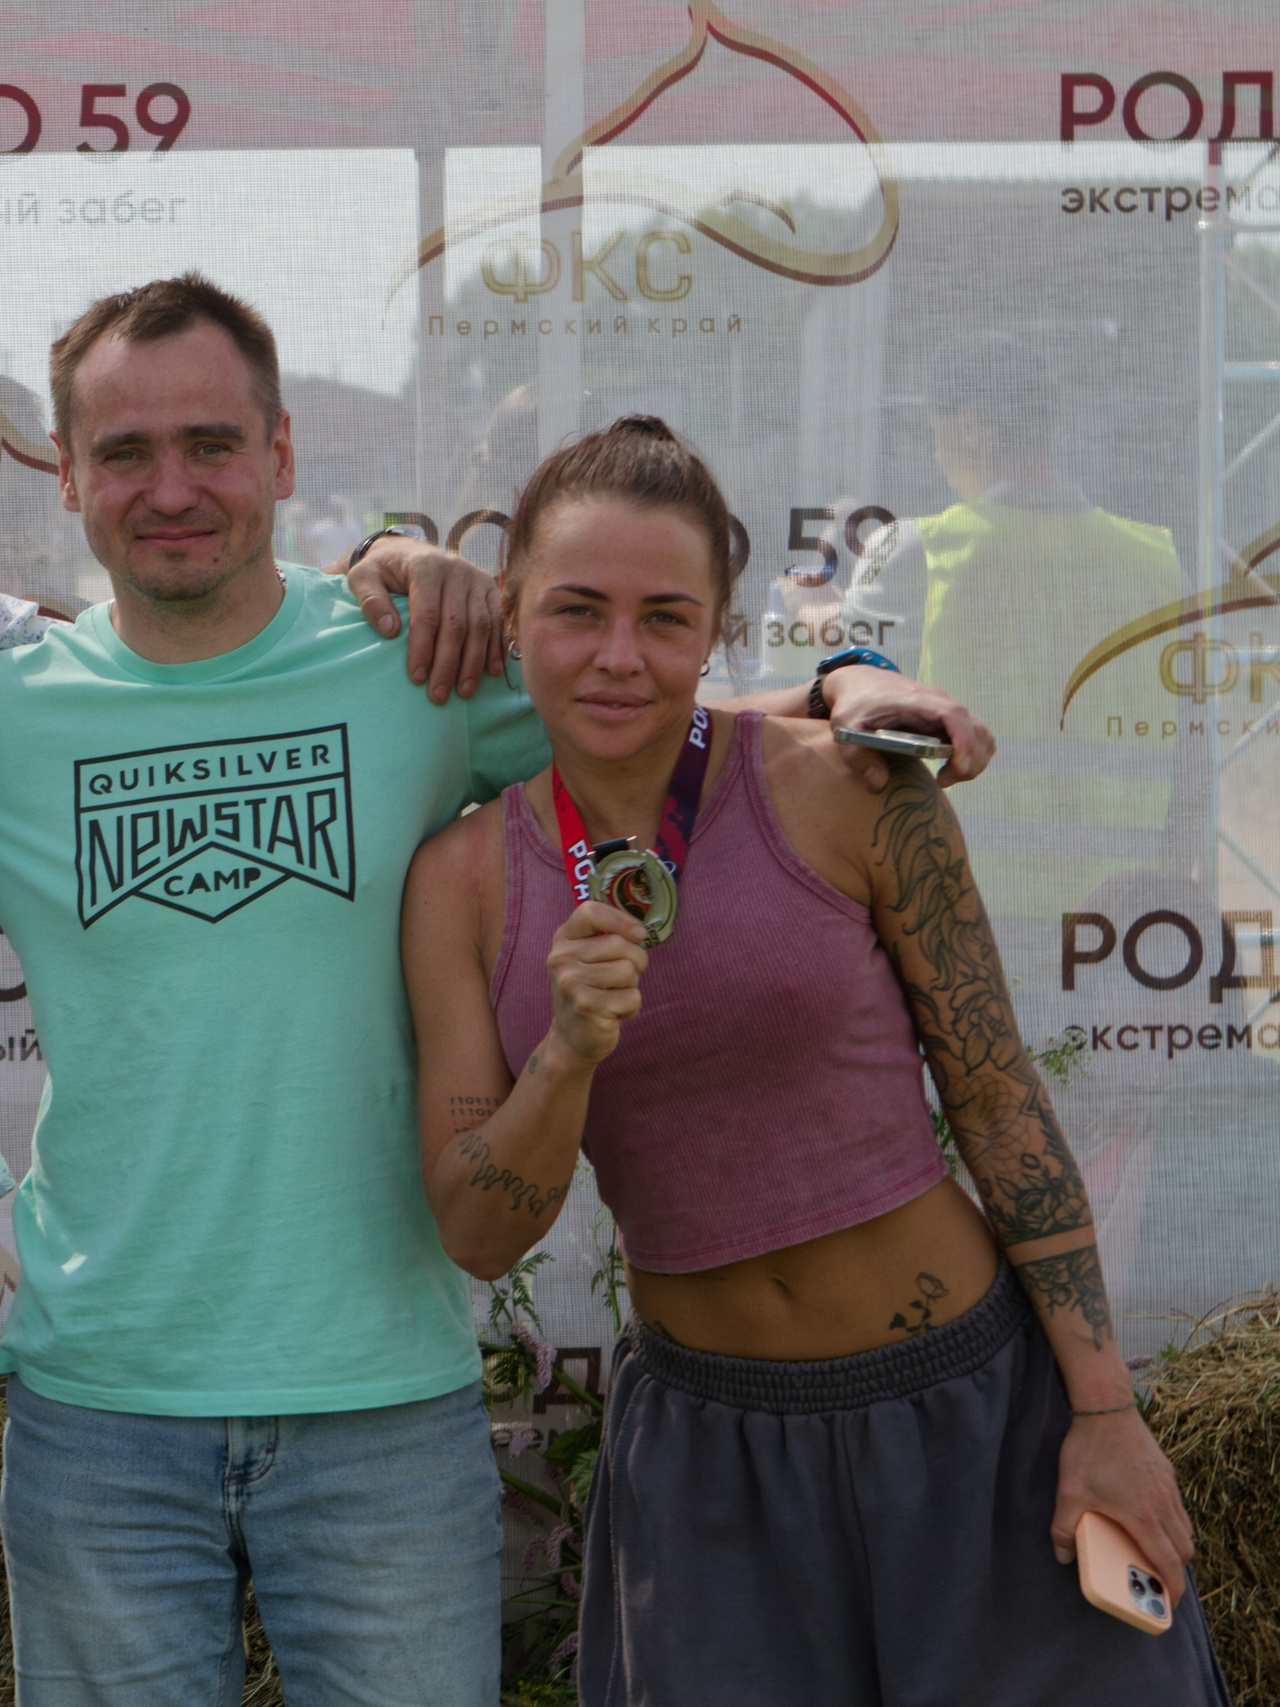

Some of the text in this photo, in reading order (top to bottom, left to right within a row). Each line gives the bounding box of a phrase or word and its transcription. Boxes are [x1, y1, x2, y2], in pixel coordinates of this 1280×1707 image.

[76, 82, 191, 164] 59
[58, 190, 186, 225] забег
[481, 229, 693, 305] ФКС
[428, 314, 742, 341] Пермский край
[765, 612, 896, 649] забег
[88, 744, 331, 796] QUIKSILVER
[163, 866, 262, 897] CAMP
